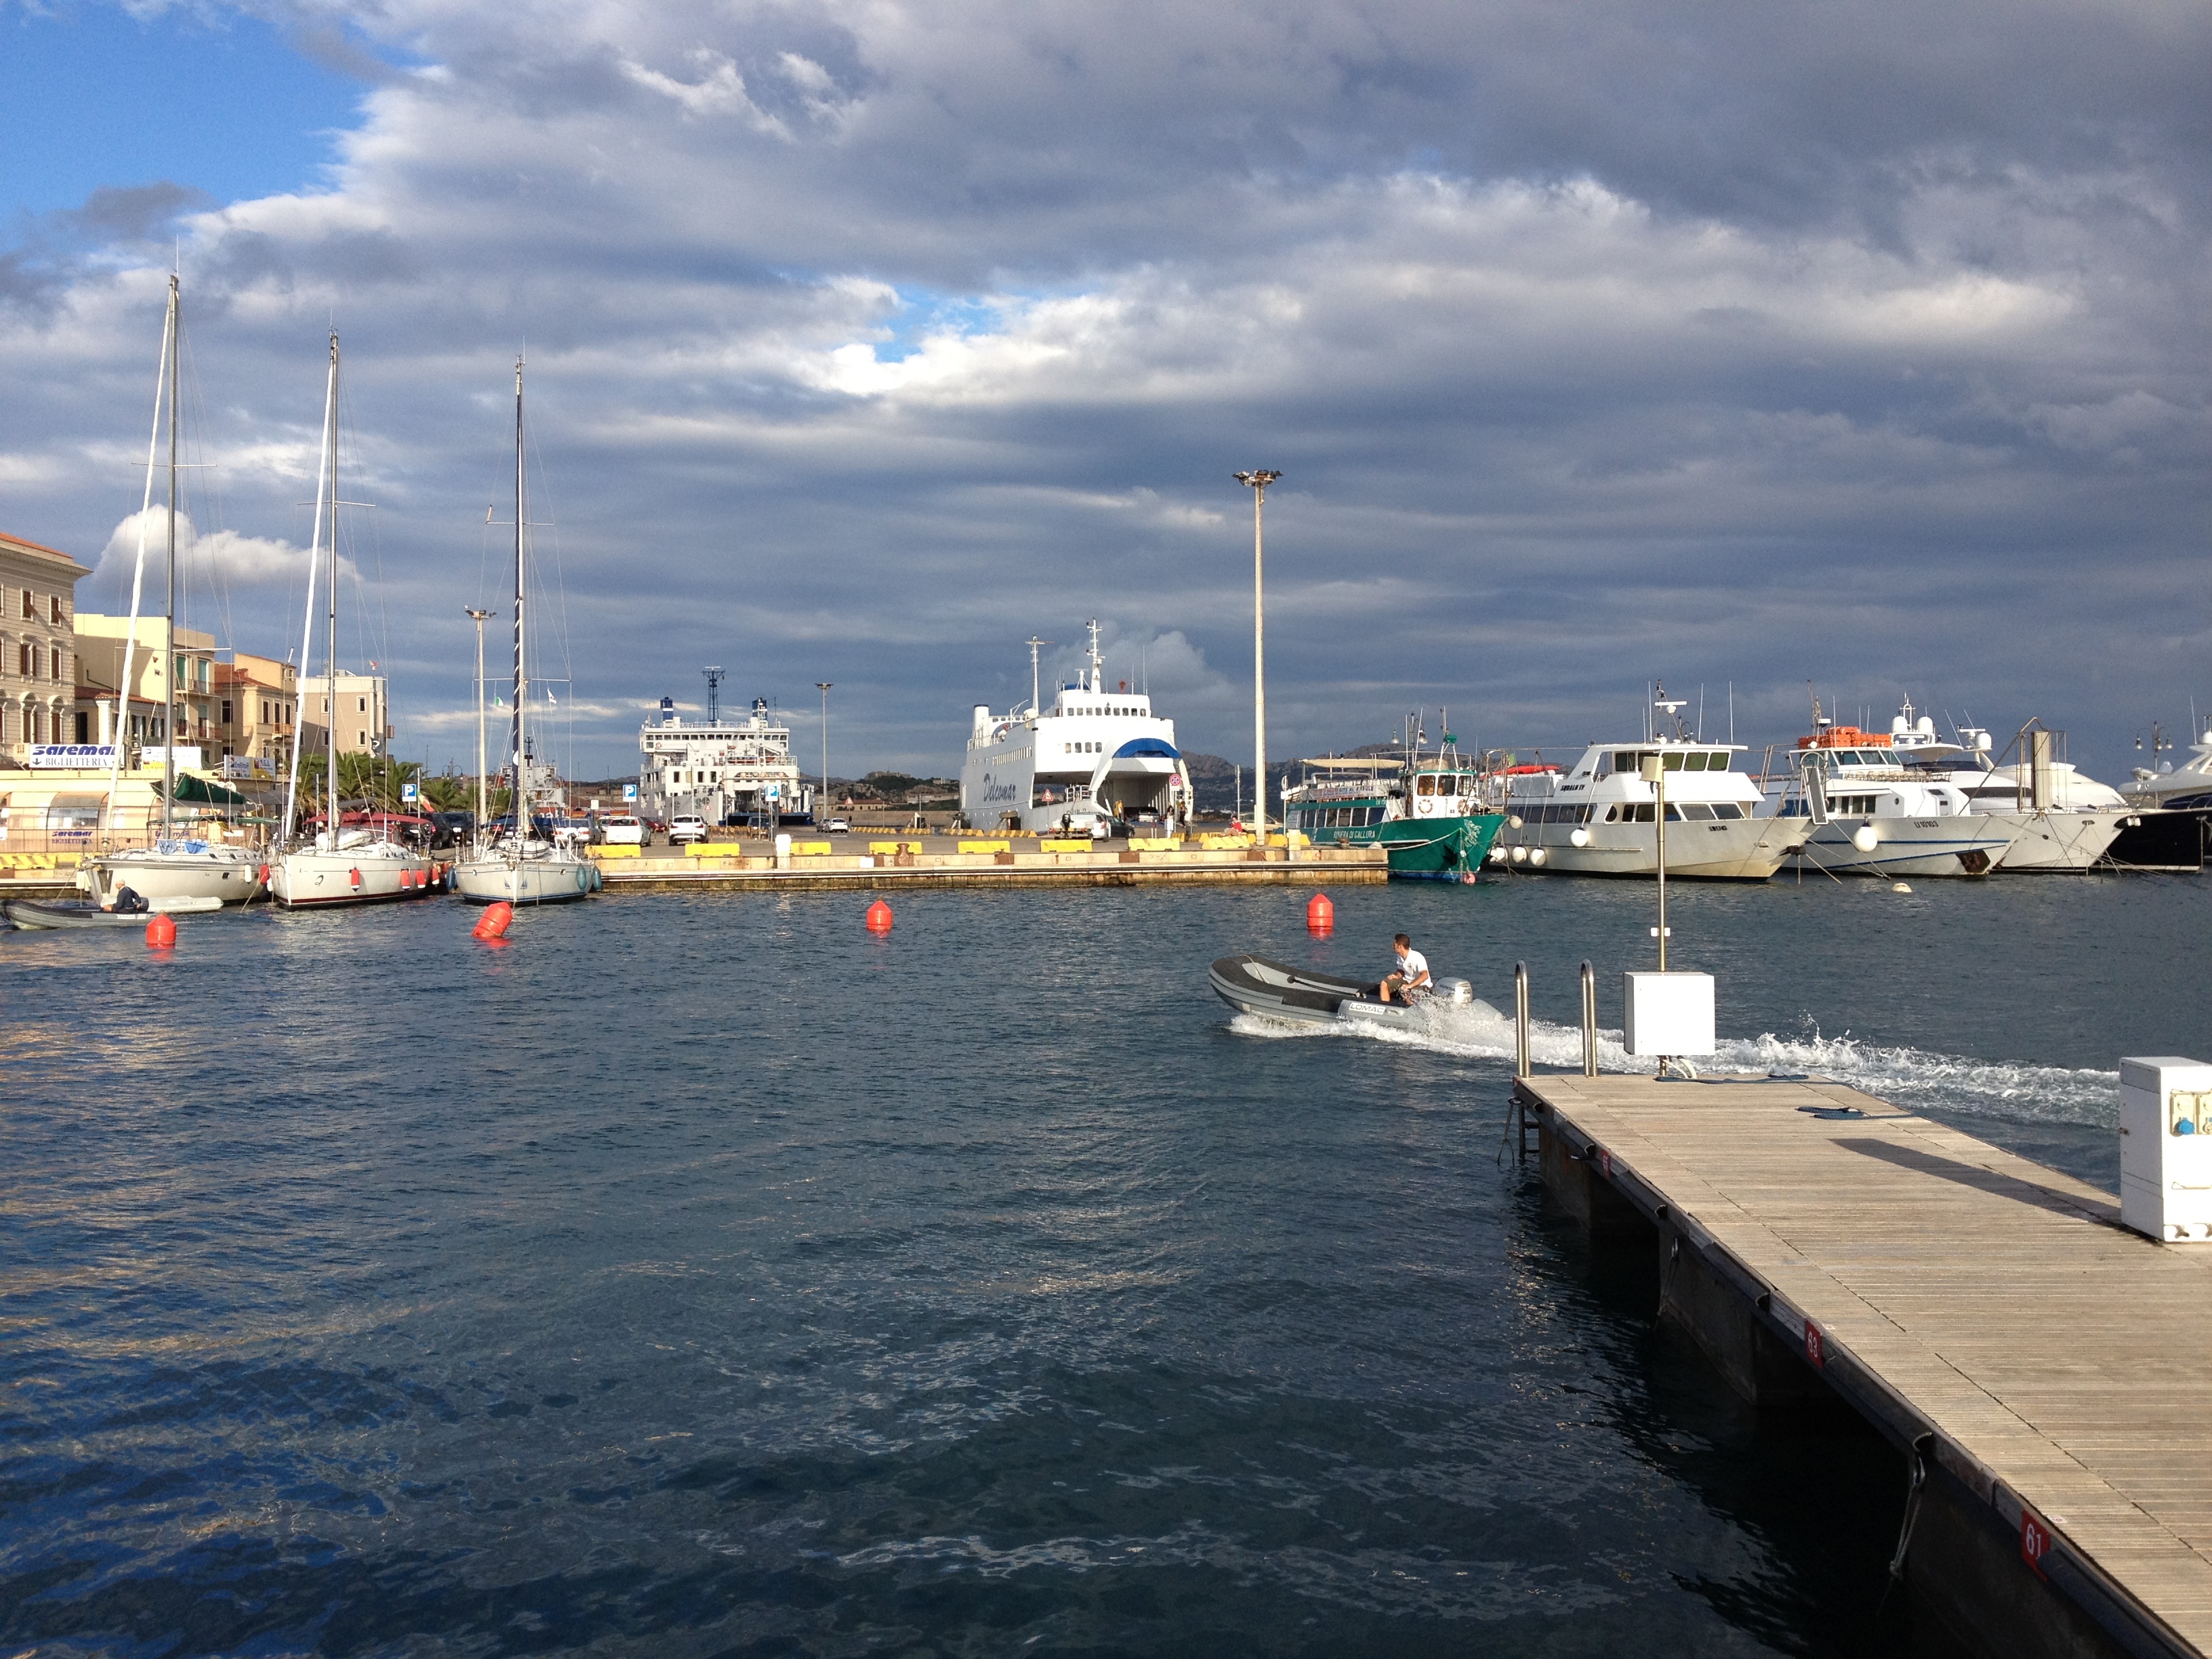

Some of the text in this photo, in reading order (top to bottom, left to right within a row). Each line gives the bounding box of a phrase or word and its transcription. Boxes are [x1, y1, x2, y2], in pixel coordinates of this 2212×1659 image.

[45, 758, 107, 766] BIGLIETTERIA
[405, 785, 414, 796] P
[625, 786, 634, 796] P
[767, 786, 776, 796] P
[983, 773, 1017, 802] Delcomar
[1333, 831, 1349, 839] RIVIERA
[1354, 830, 1376, 838] GALLURA
[1808, 1330, 1818, 1358] 63
[2026, 1523, 2041, 1560] 61
